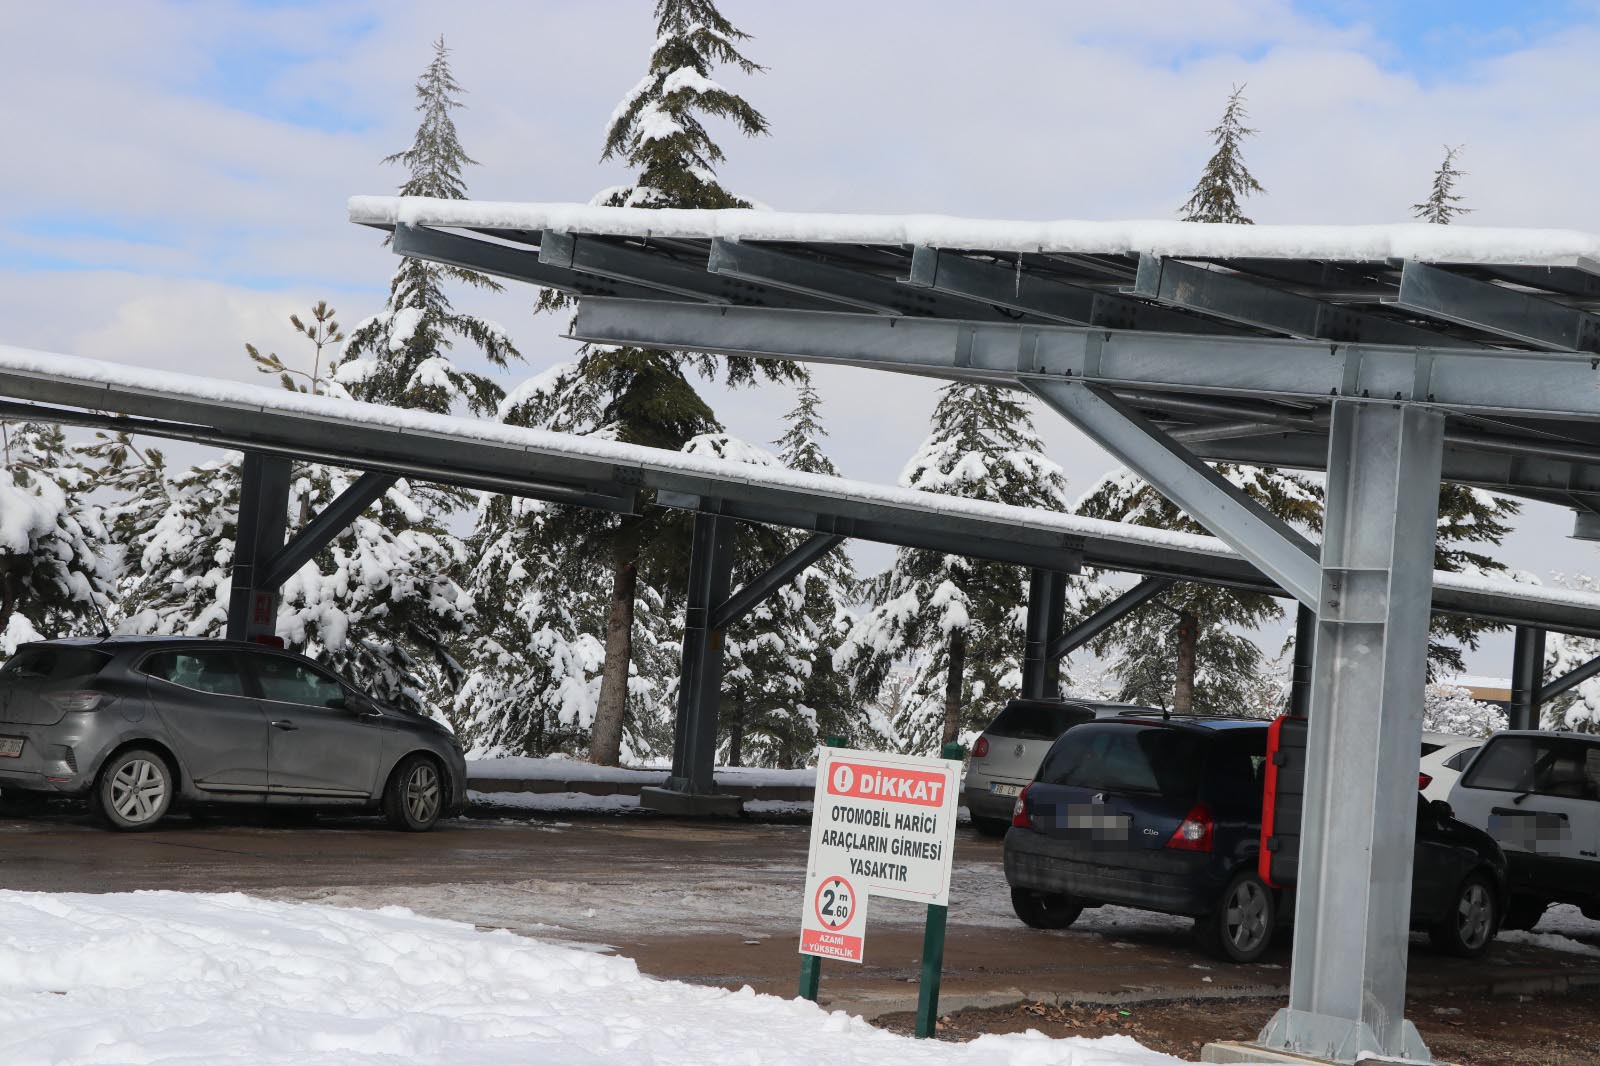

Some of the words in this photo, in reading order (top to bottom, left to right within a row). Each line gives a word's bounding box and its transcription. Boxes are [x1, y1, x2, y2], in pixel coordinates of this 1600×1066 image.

[860, 771, 942, 801] DİKKAT
[831, 805, 891, 828] OTOMOBİL
[894, 812, 937, 834] HARİCİ
[1143, 828, 1159, 836] Clio
[821, 829, 888, 852] ARAÇLARIN
[891, 835, 942, 861] GİRMESİ
[849, 858, 908, 882] YASAKTIR
[809, 943, 853, 957] YÜKSEKLİK
[819, 935, 844, 945] AZAMİ
